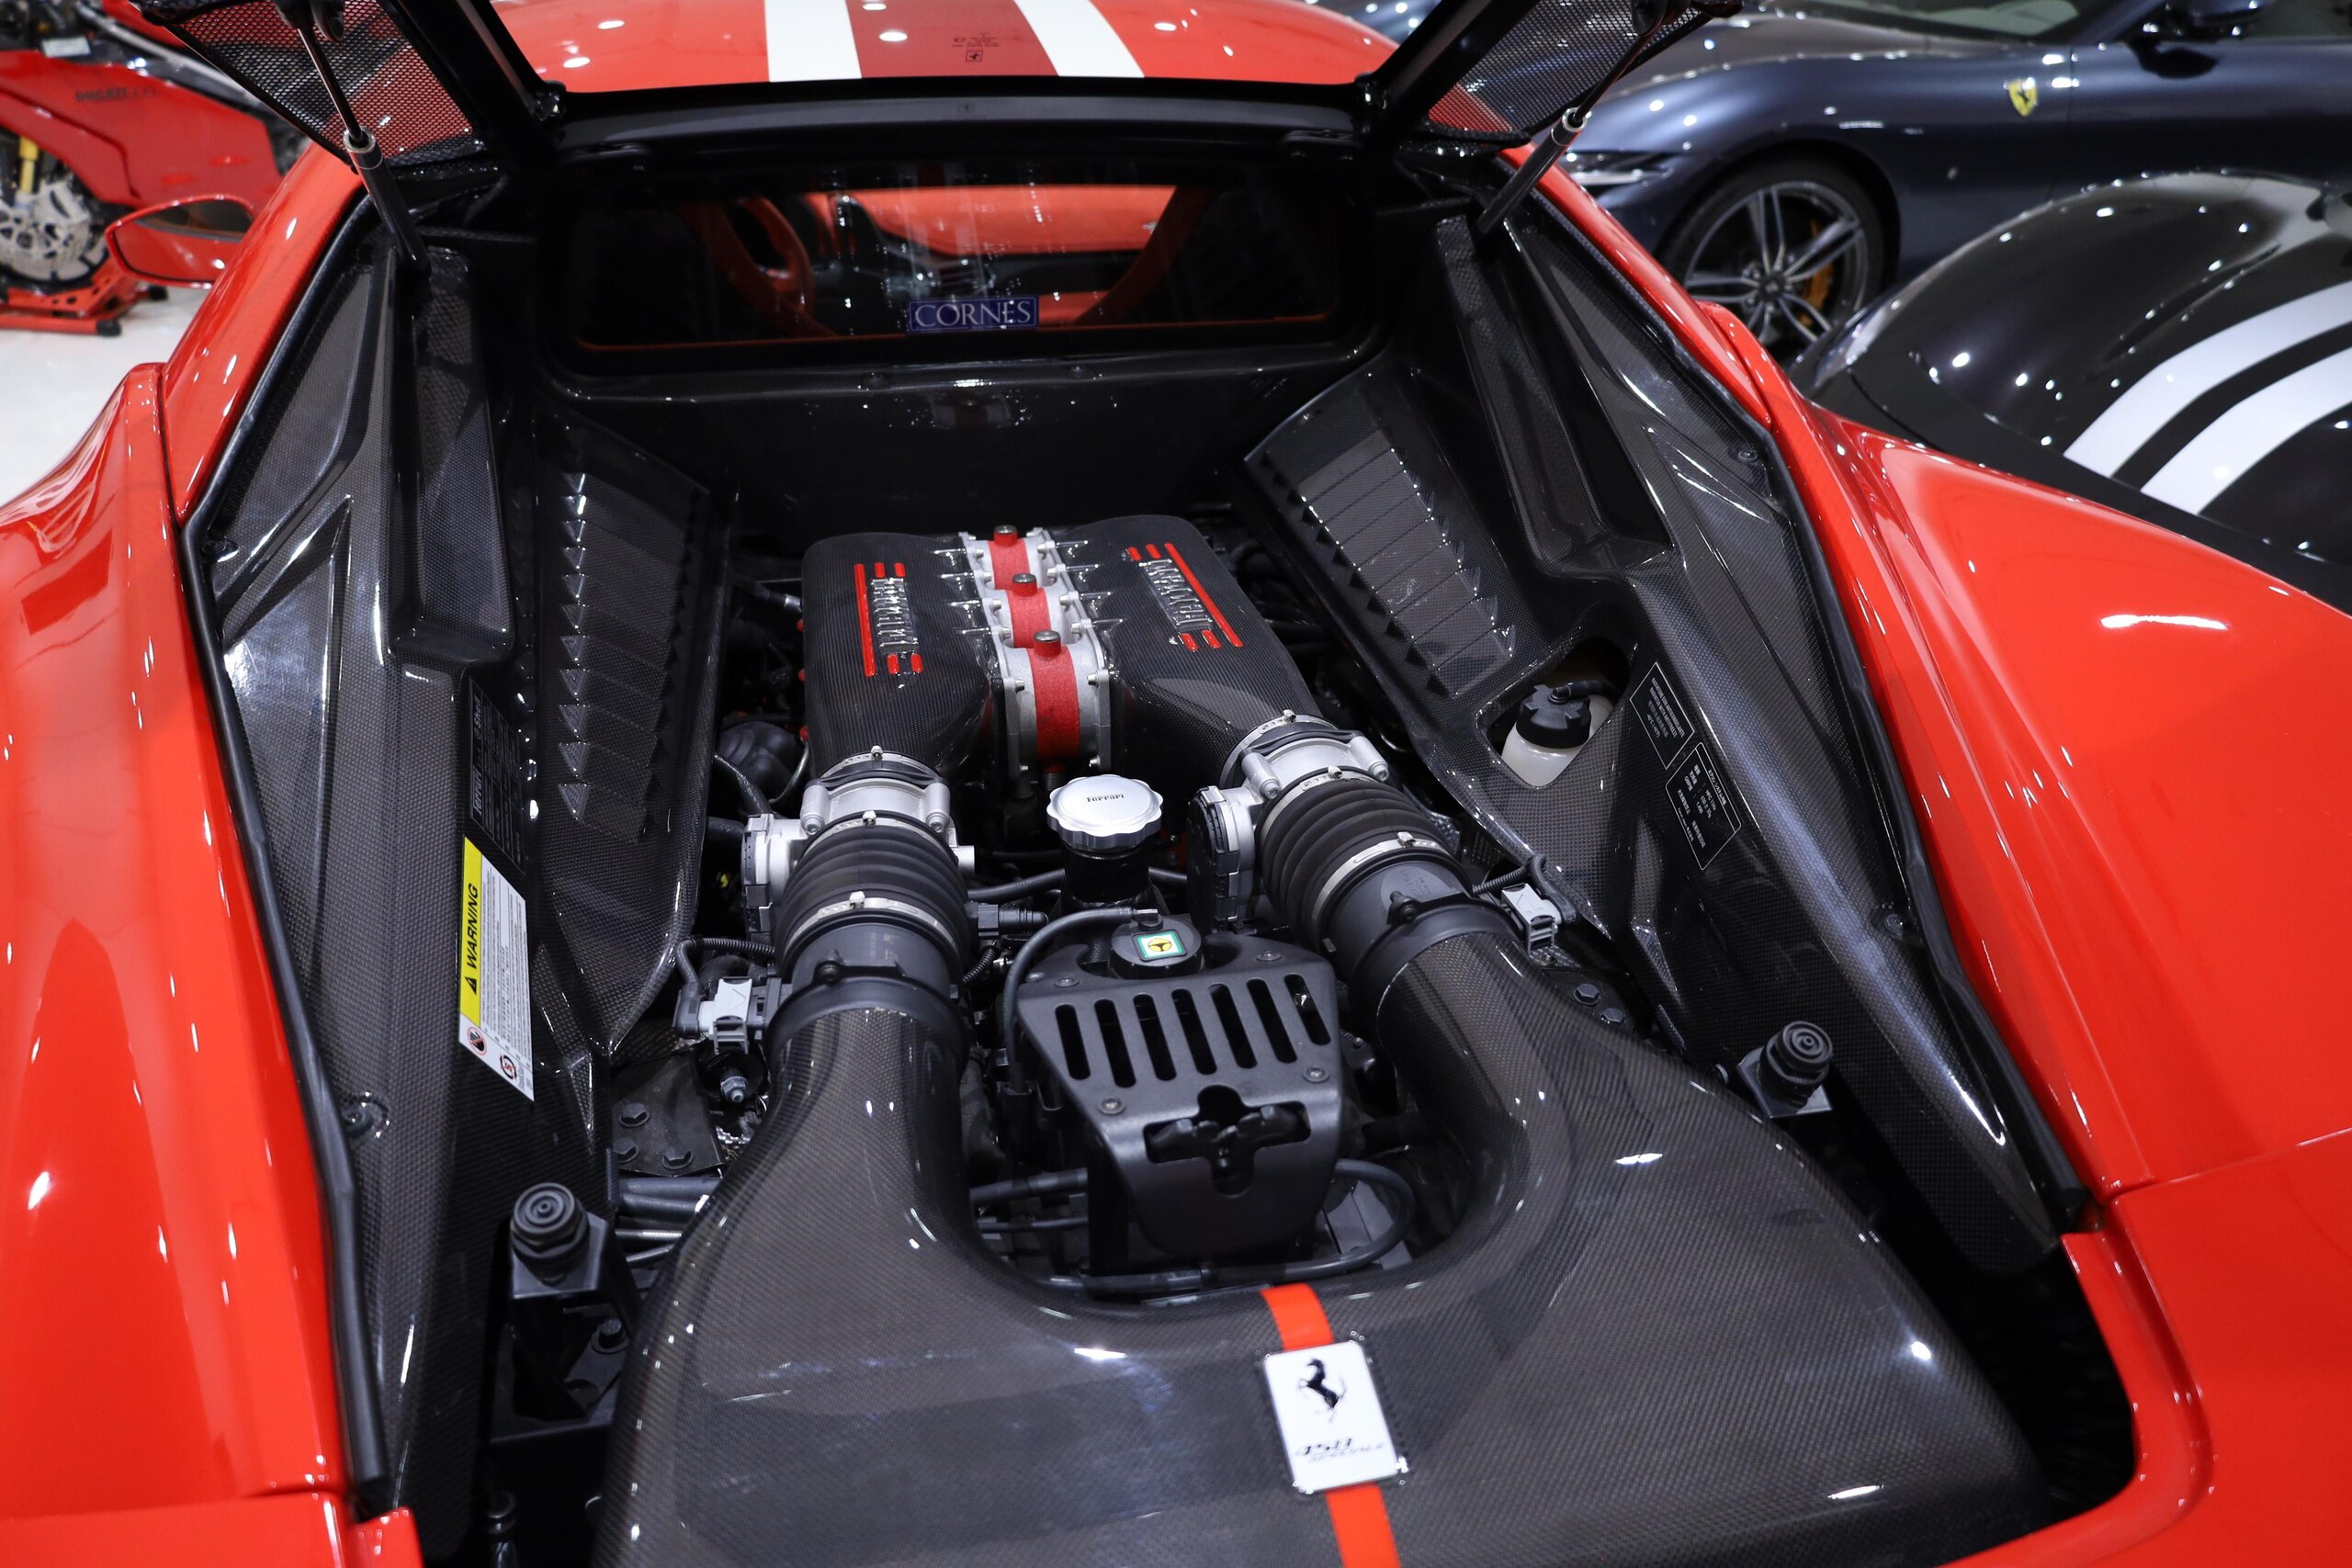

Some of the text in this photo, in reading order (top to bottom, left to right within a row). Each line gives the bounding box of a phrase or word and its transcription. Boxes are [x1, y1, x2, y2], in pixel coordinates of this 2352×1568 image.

[915, 300, 1031, 327] CORNES
[472, 766, 482, 816] Ferrari
[1087, 794, 1125, 802] Ferrari
[467, 883, 478, 969] WARNING
